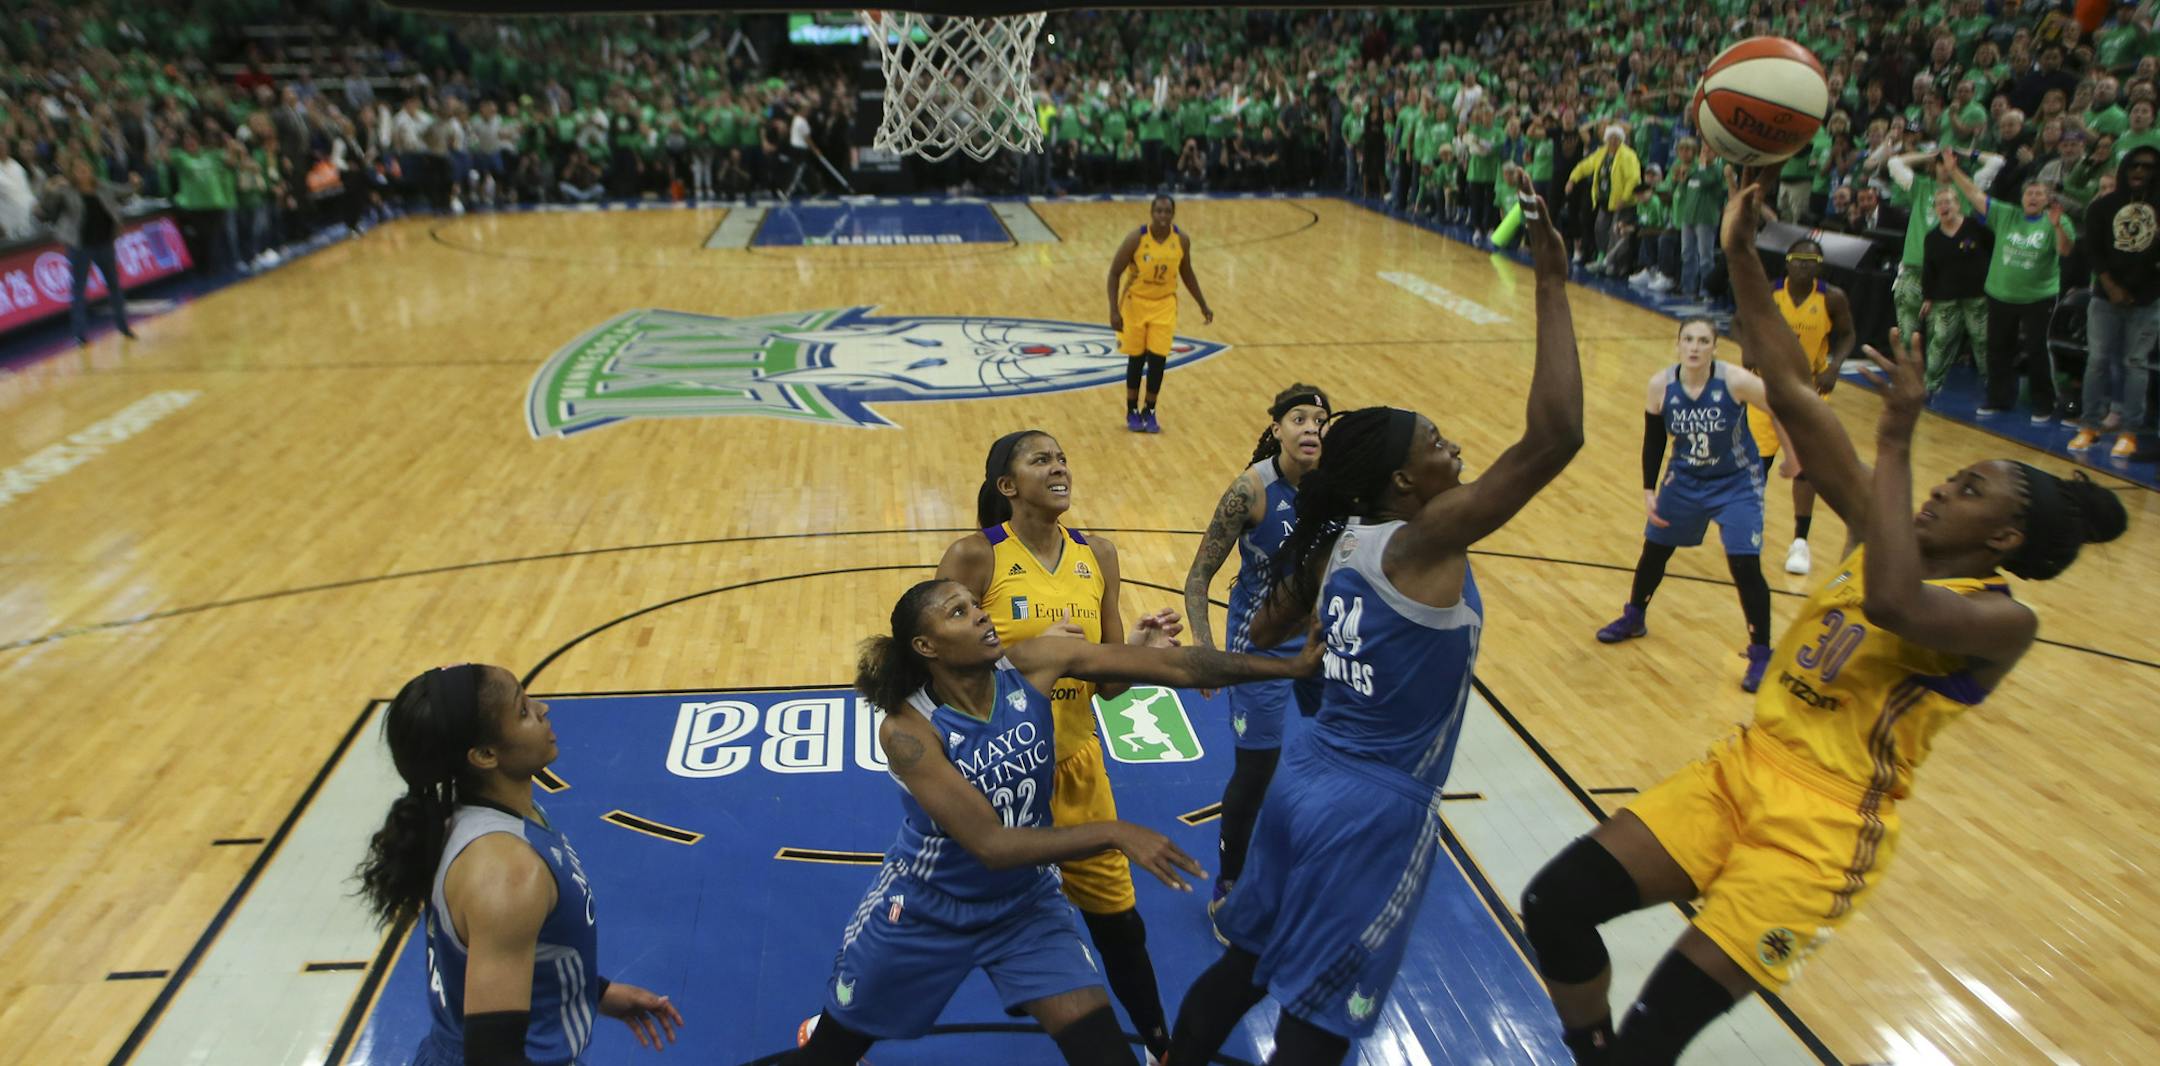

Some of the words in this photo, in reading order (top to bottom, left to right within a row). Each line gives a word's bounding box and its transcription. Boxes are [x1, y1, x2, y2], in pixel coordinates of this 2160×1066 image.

[1153, 264, 1168, 280] 12
[1671, 419, 1726, 433] CLINIC
[1672, 406, 1721, 421] MAYO
[1687, 433, 1709, 458] 13
[1034, 601, 1098, 622] EquTrust
[1328, 595, 1363, 656] 34
[1797, 608, 1866, 683] 30
[955, 721, 1036, 779] MAYO
[971, 740, 1049, 794] LINIC
